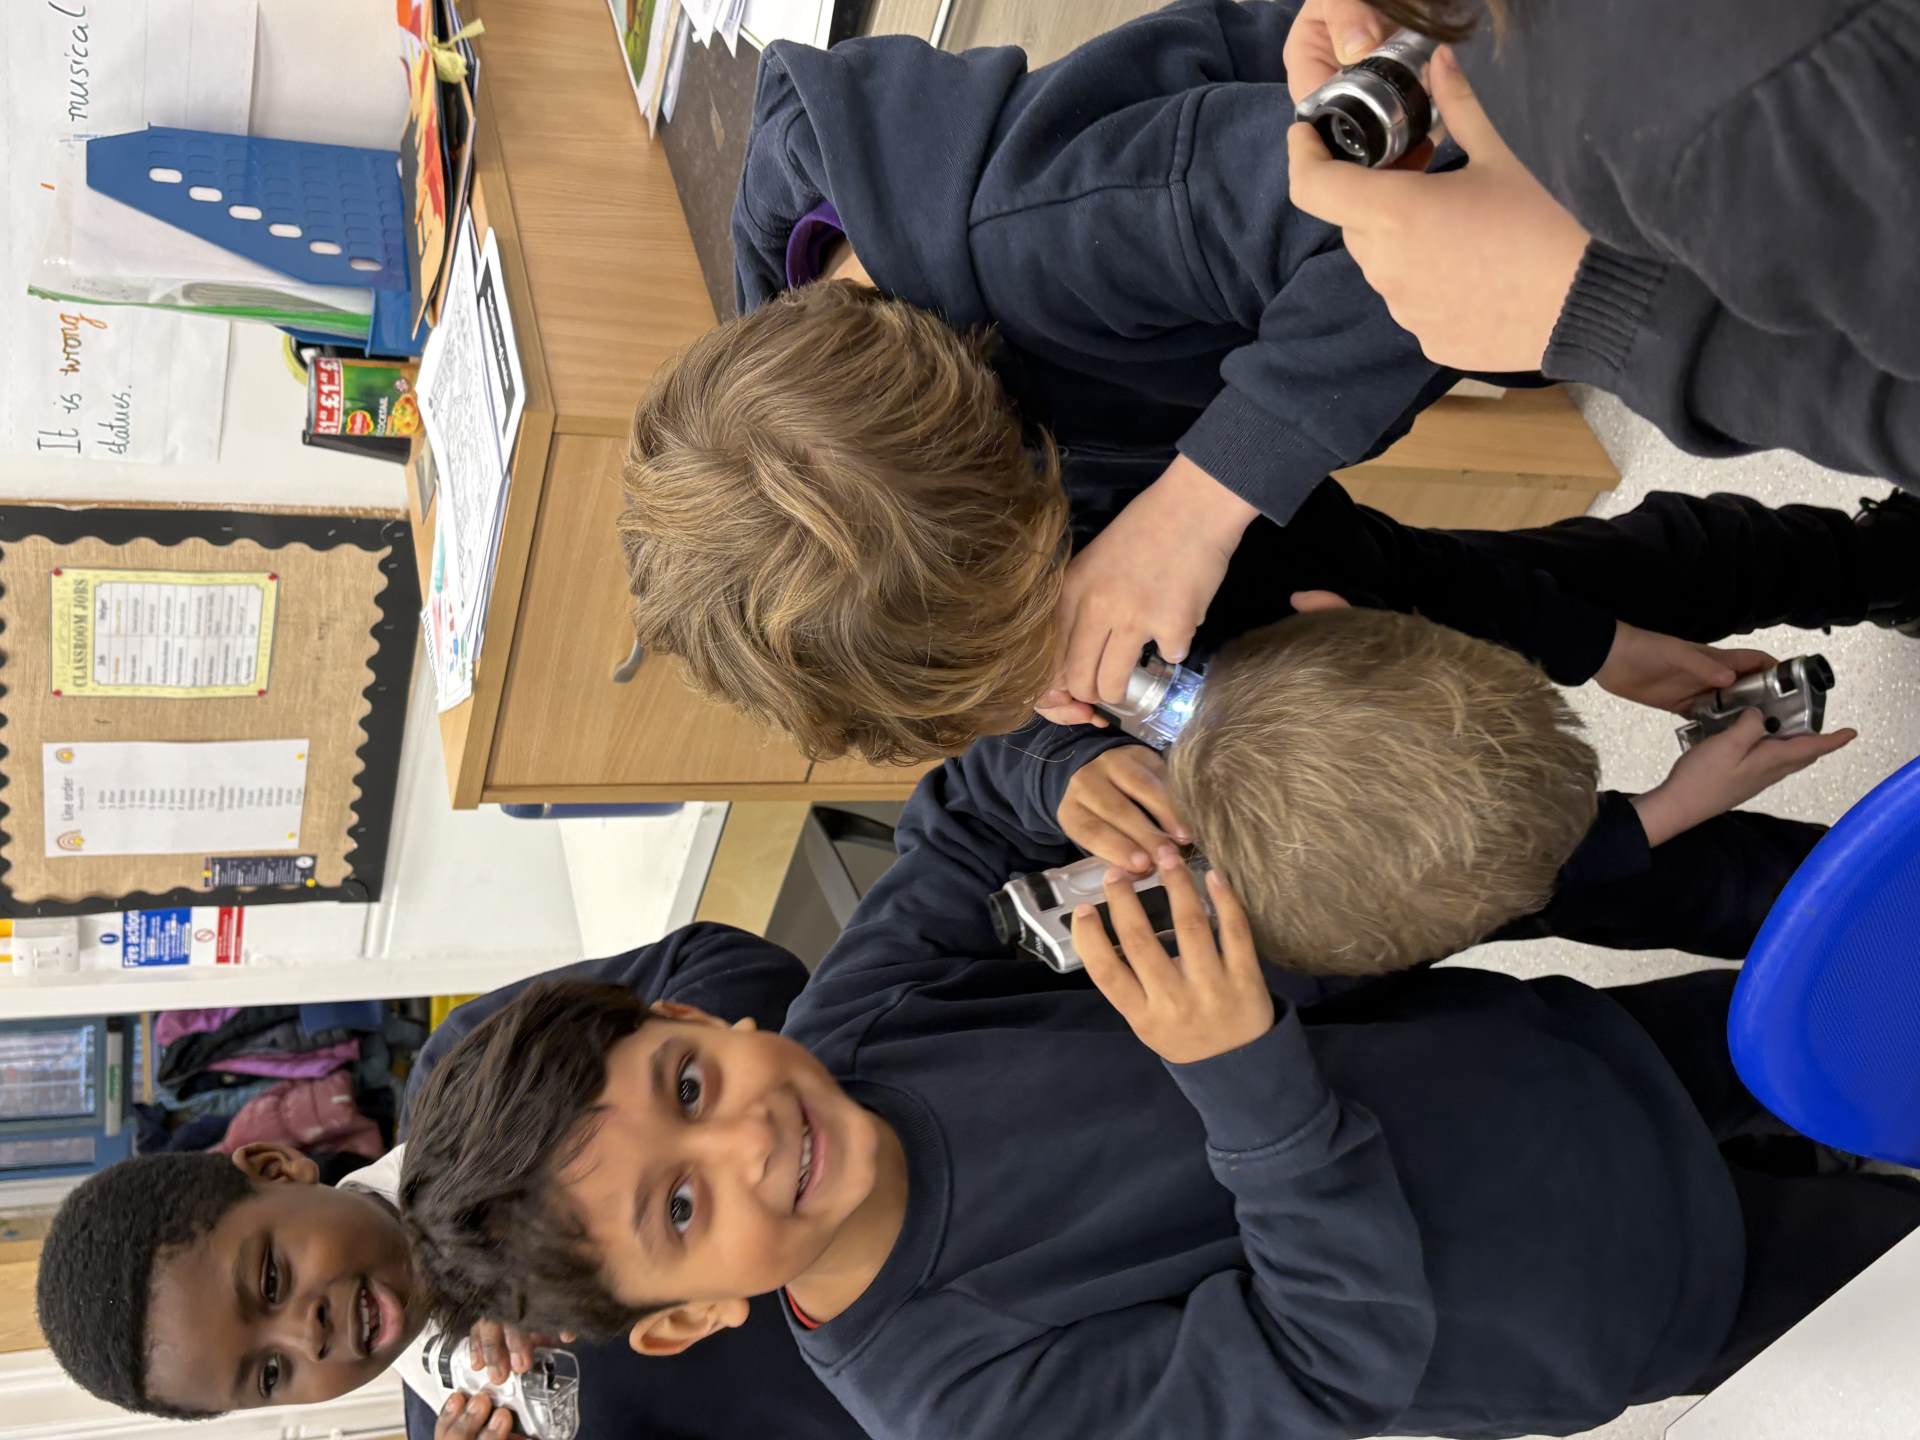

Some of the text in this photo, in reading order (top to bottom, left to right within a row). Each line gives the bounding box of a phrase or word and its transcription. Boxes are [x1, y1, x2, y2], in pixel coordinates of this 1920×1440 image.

[48, 1, 89, 122] musical
[58, 313, 108, 376] wrong
[53, 393, 82, 414] is
[96, 385, 132, 455] statues.
[36, 428, 82, 455] It
[72, 579, 88, 688] CLASSROOM JOBS
[62, 777, 74, 821] Line order
[124, 910, 140, 966] Fire action
